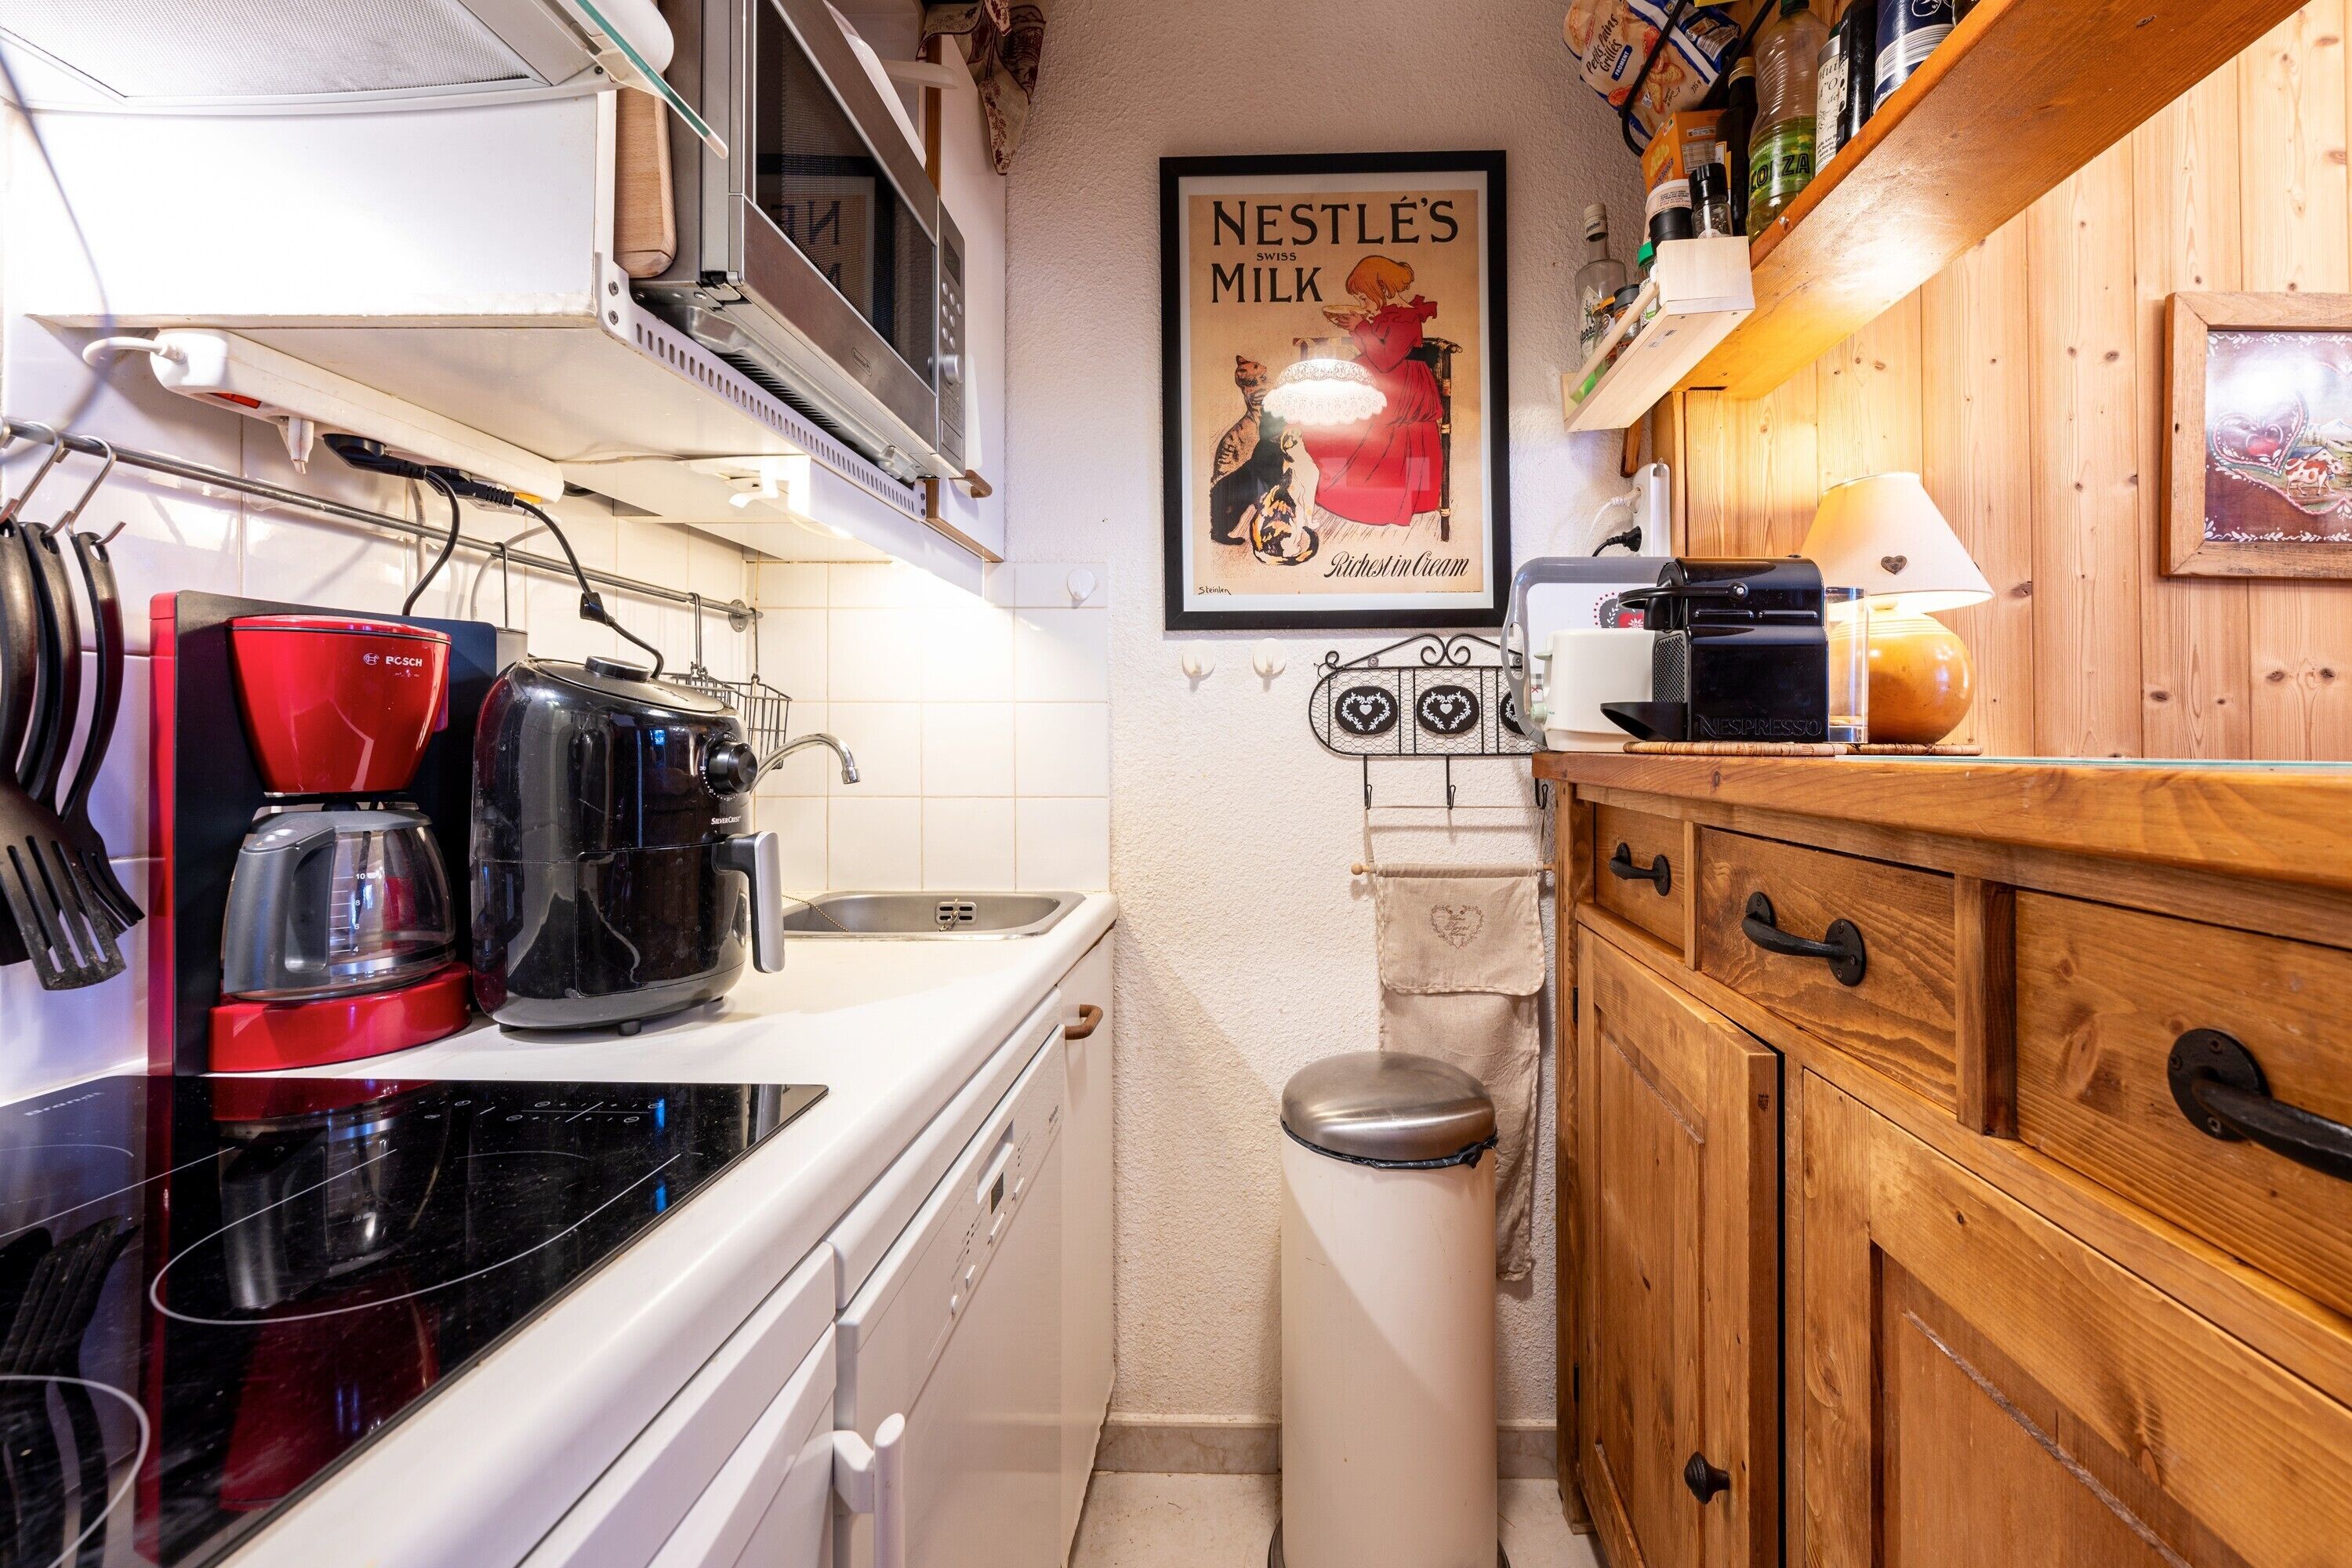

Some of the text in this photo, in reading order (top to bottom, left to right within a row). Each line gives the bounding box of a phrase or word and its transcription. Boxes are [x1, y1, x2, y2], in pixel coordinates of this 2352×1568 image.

[1586, 45, 1604, 74] Petits
[1599, 13, 1619, 48] Pains
[1600, 39, 1623, 72] Grillés
[1614, 51, 1629, 76] FROMENT
[1213, 196, 1459, 246] NESTLÉ'S
[1256, 252, 1298, 262] SWISS
[1211, 263, 1323, 303] MILK
[1323, 550, 1469, 579] Richest in Cream
[386, 655, 423, 667] BOSCH
[1697, 714, 1823, 739] NESPRESSO
